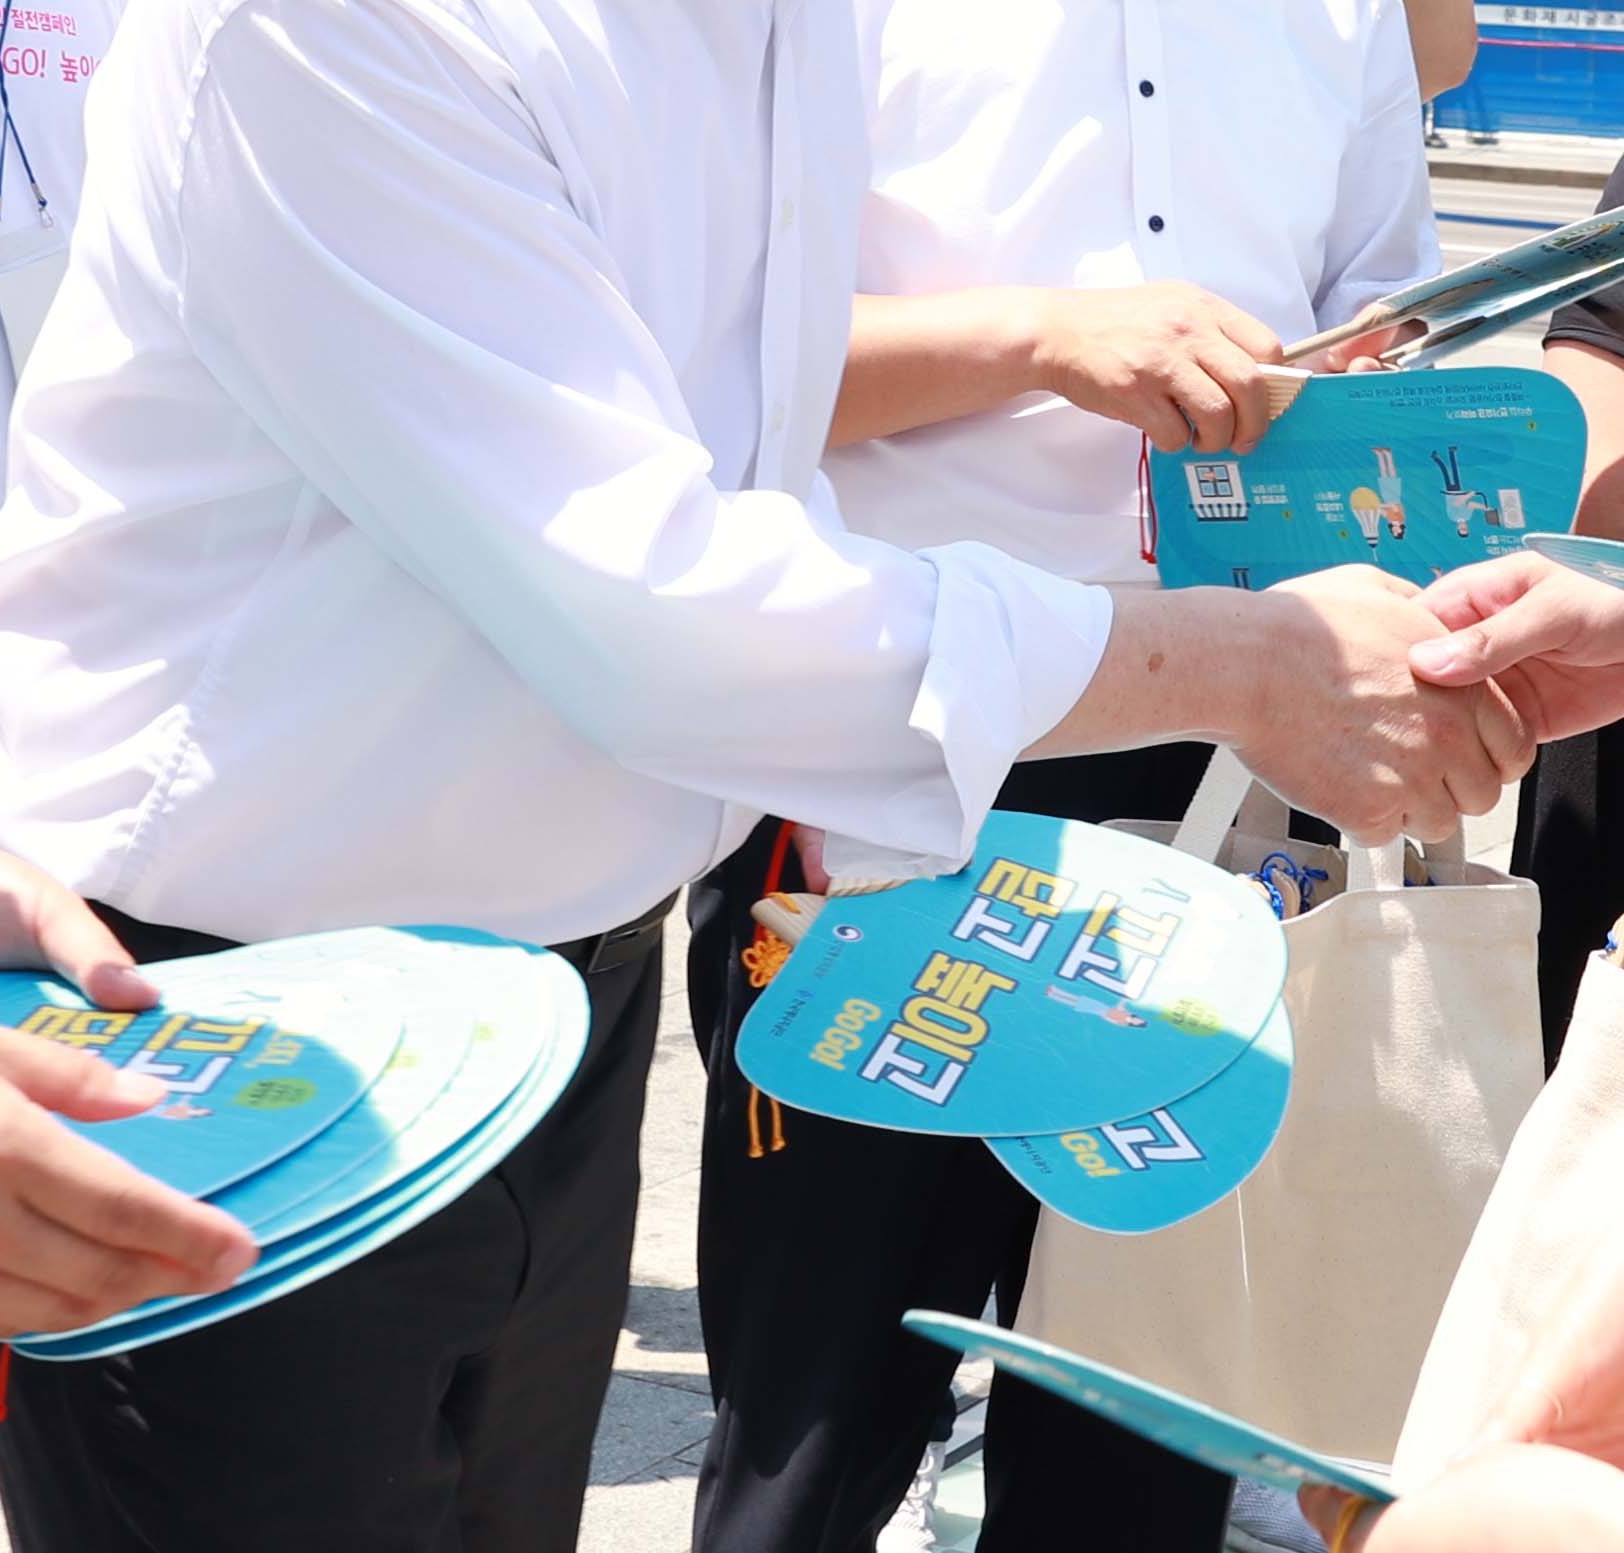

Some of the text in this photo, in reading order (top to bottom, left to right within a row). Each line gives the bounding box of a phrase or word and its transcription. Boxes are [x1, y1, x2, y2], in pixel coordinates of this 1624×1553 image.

[60, 50, 100, 83] 높이
[952, 857, 1079, 963] 닫고
[1057, 890, 1181, 1000] 끄고
[809, 999, 882, 1071] GoGo!
[857, 951, 1019, 1107] 높이고
